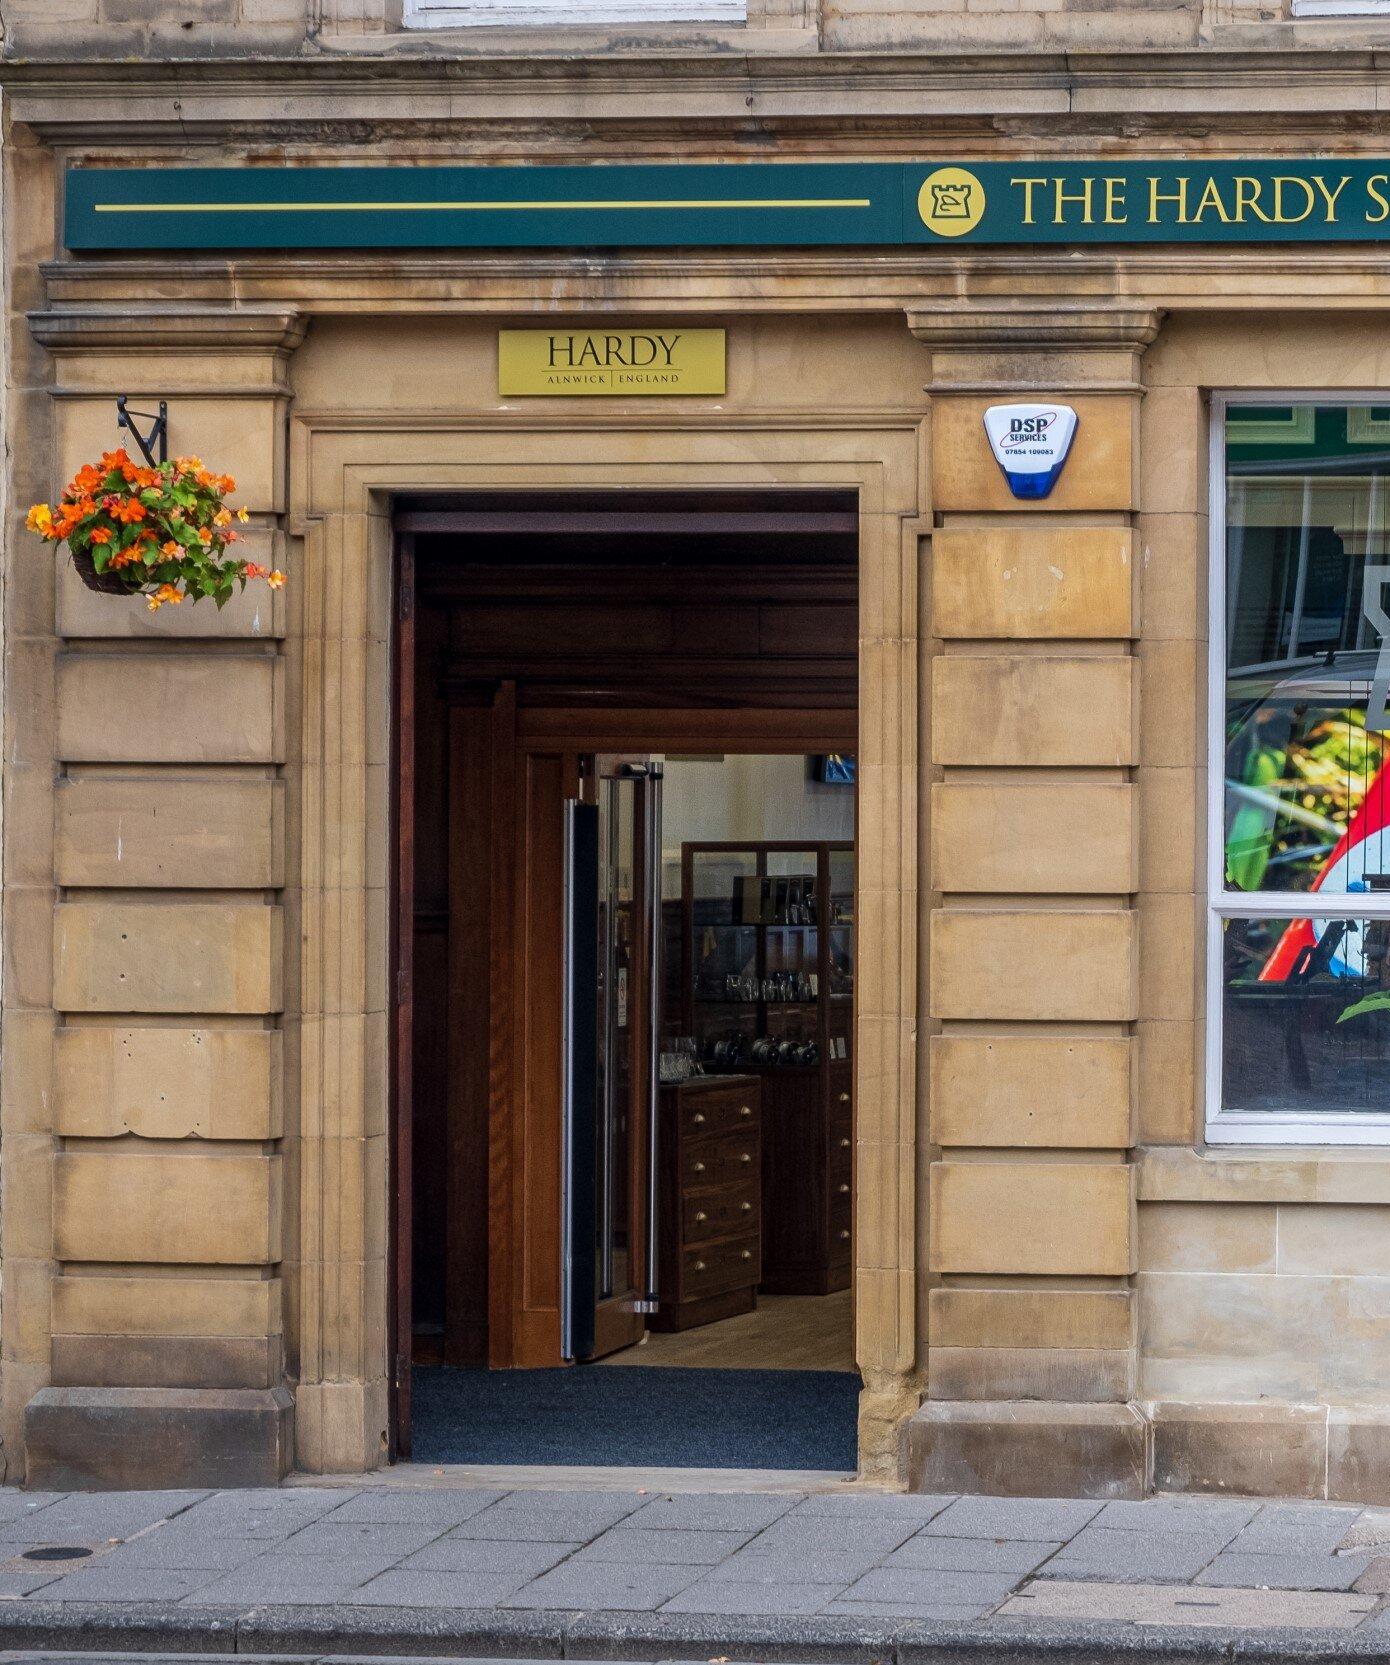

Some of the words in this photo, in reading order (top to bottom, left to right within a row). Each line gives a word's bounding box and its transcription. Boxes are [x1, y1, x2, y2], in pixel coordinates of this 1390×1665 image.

[1010, 176, 1127, 224] THE
[1146, 175, 1354, 224] HARDY
[548, 336, 681, 366] HARDY
[547, 375, 606, 384] ALNWICK
[619, 374, 679, 384] ENGLAND
[1011, 418, 1048, 432] DSP
